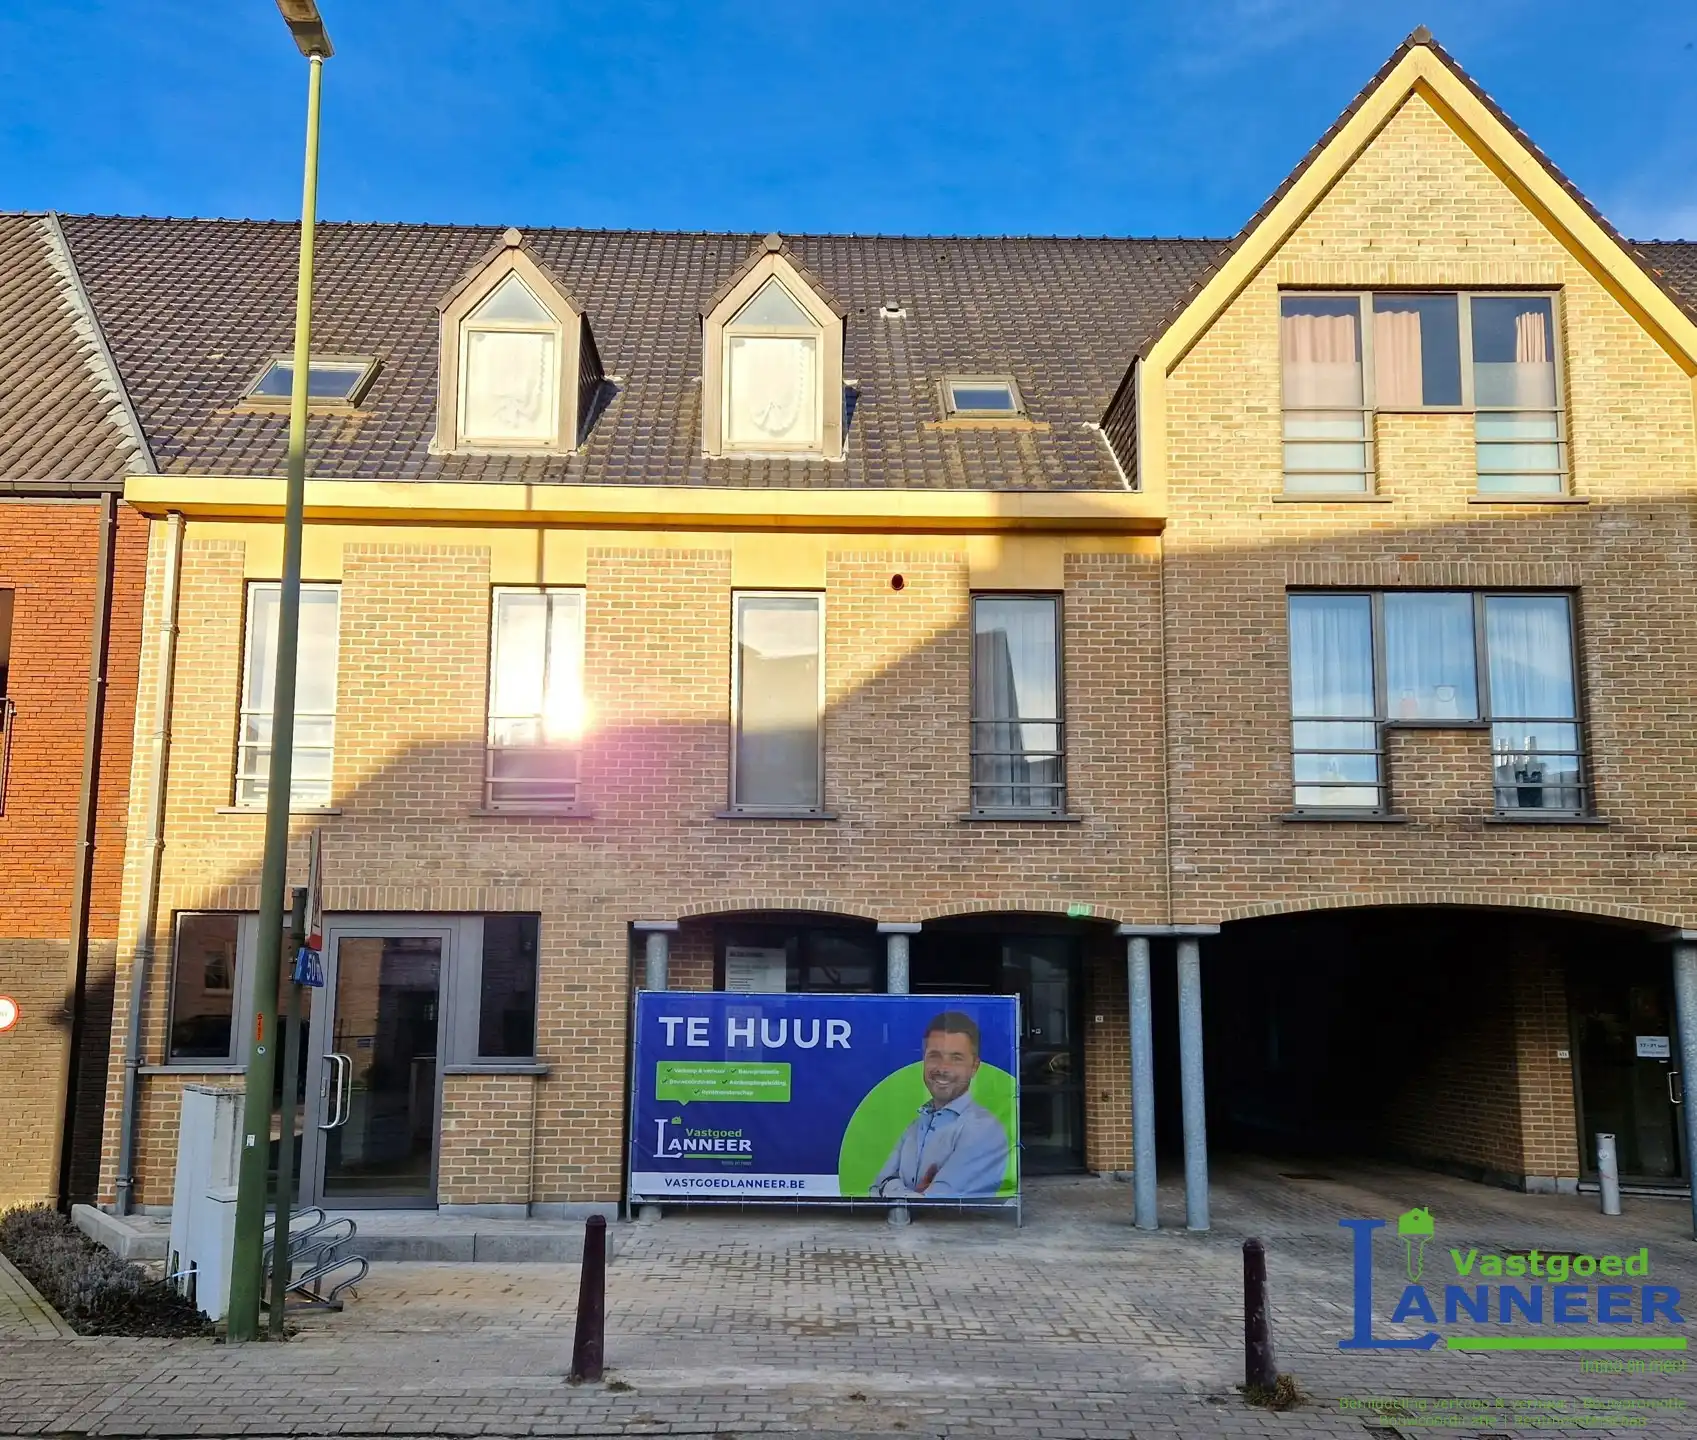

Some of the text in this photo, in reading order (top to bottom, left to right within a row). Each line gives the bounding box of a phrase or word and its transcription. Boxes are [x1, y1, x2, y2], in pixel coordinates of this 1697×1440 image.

[306, 953, 316, 981] 50
[658, 1016, 852, 1049] TE HUUR
[653, 1118, 753, 1159] LANNEER
[686, 1128, 742, 1139] Vastgoed
[664, 1178, 806, 1189] VASTGOEDLANNEER.BE
